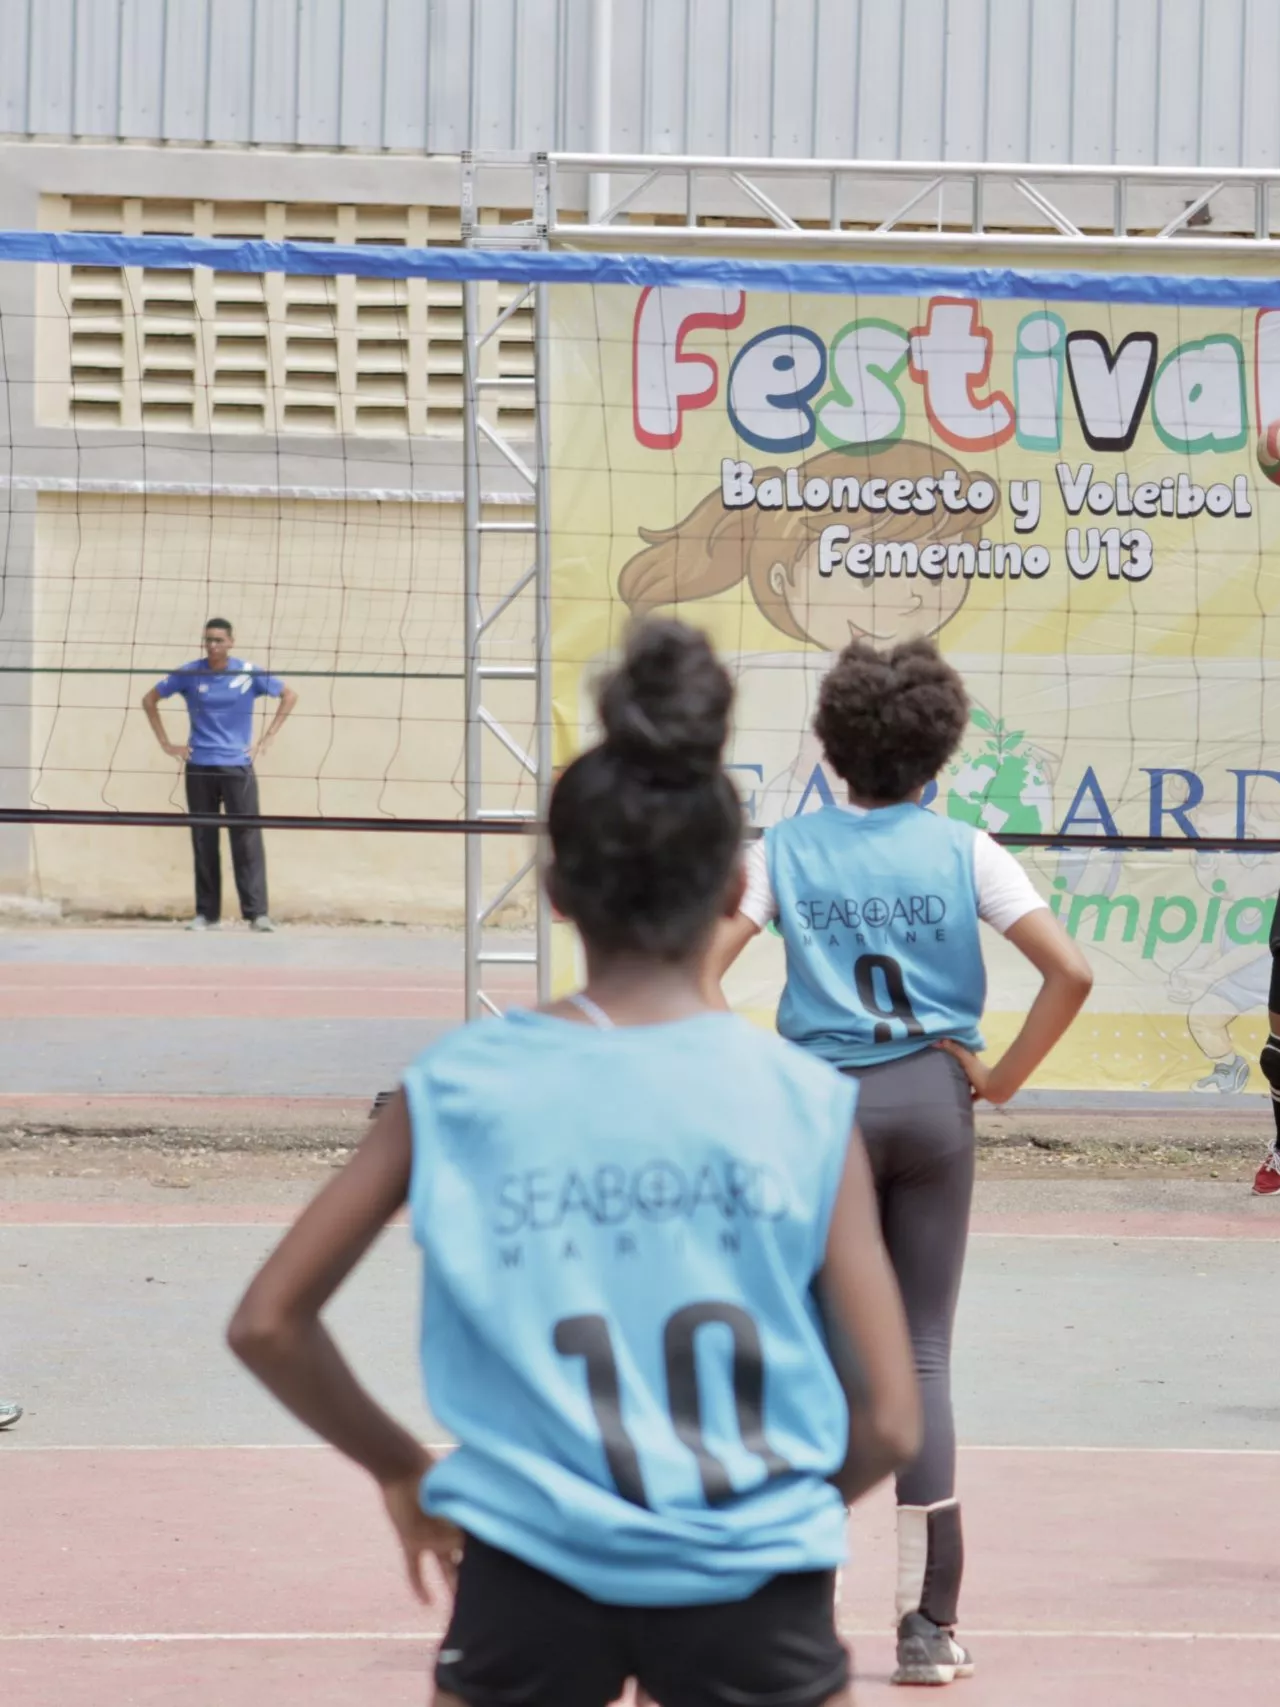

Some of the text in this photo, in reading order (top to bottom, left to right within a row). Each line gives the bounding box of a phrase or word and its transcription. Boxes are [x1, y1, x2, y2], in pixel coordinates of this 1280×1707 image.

[720, 458, 1252, 533] Baloncesto y Voleibol
[818, 524, 1153, 581] Femenino U13
[795, 894, 947, 931] SEABOARD
[803, 928, 948, 947] MARINE
[552, 1300, 793, 1511] 10
